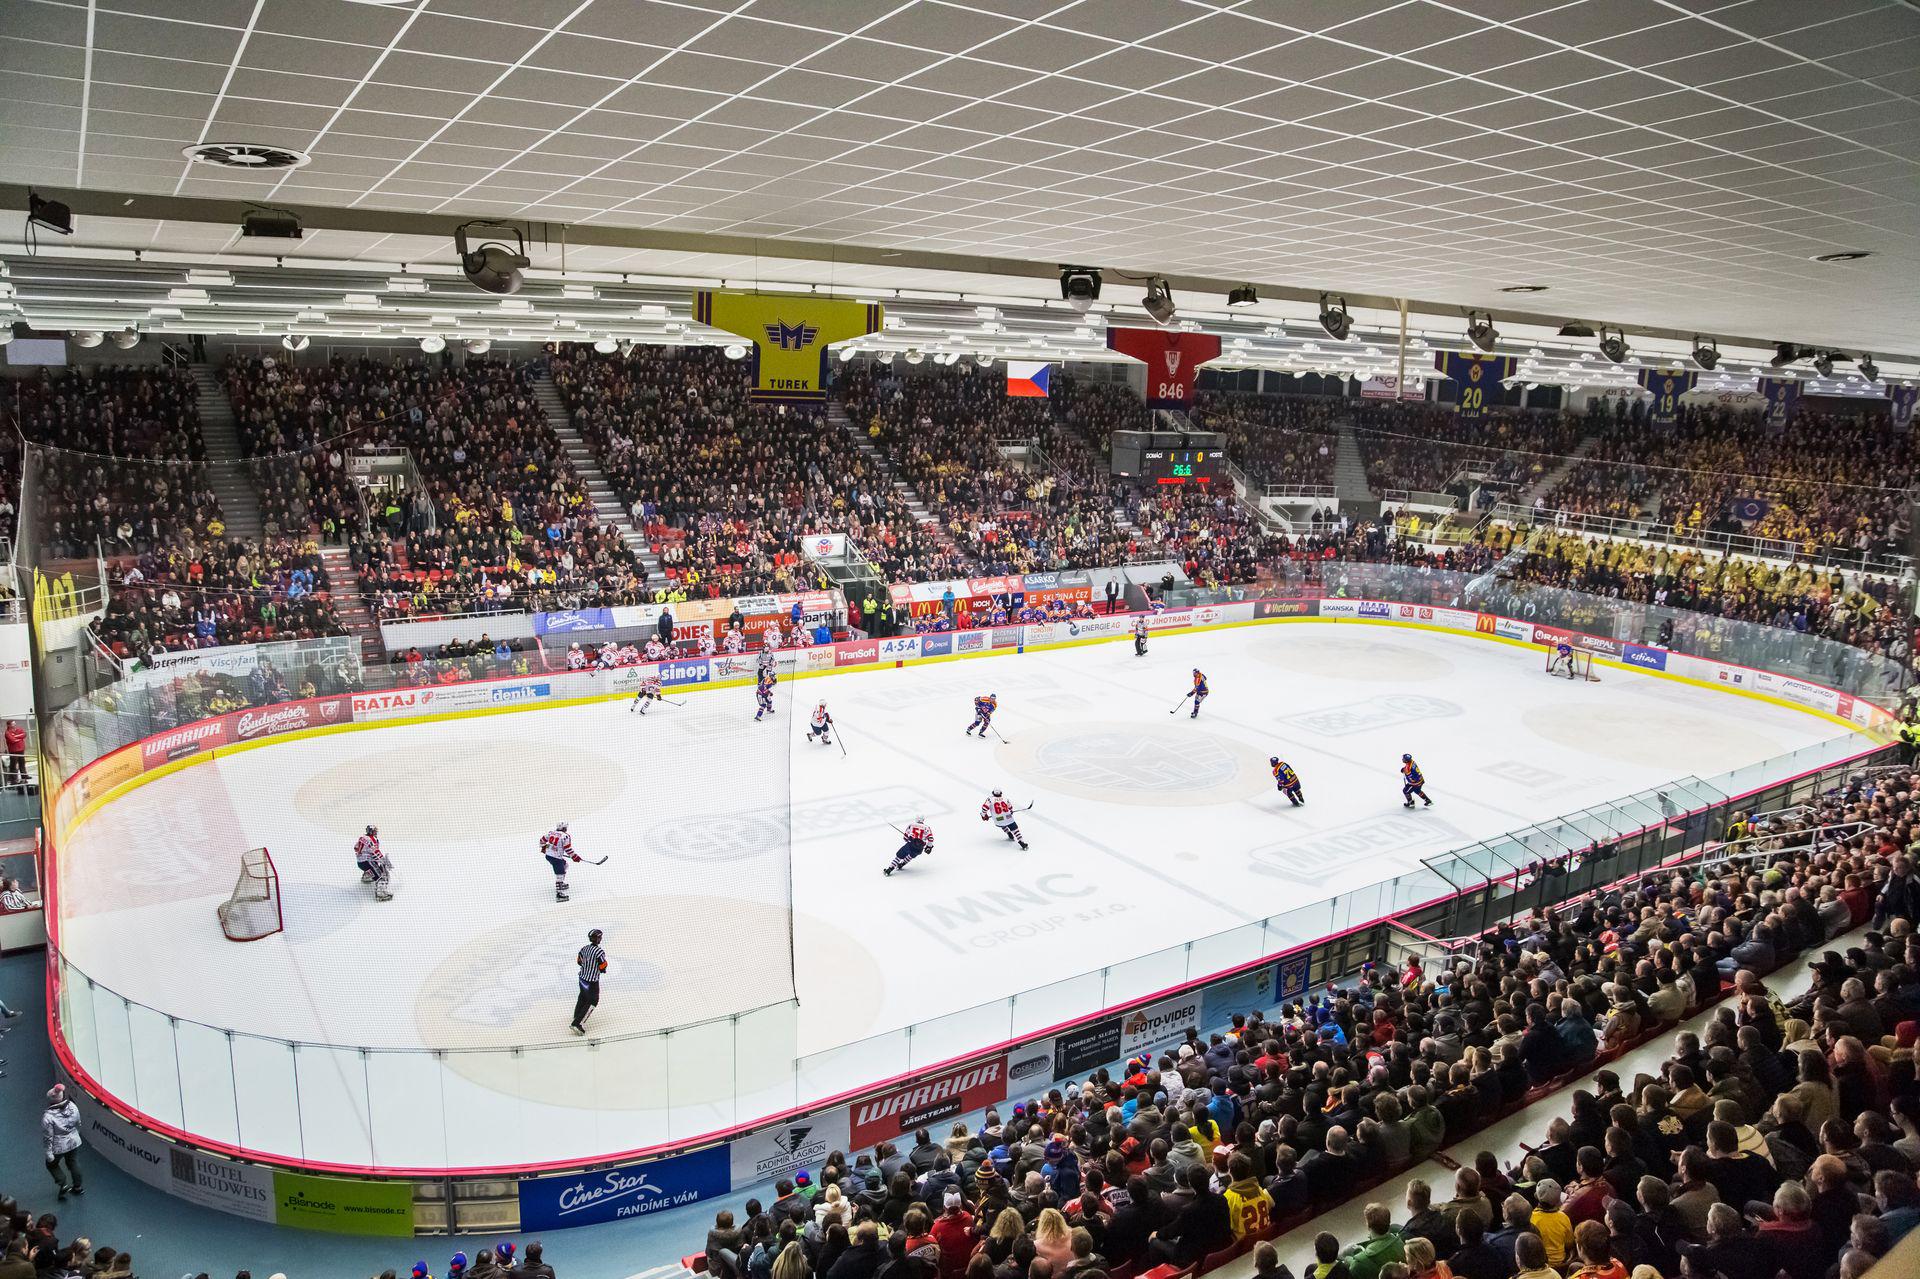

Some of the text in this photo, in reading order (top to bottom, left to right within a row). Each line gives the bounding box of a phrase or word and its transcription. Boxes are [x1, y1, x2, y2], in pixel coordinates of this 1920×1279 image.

[770, 378, 808, 390] TUREK
[1158, 382, 1184, 399] 846
[1462, 387, 1482, 409] 20
[1660, 394, 1674, 413] 19
[1773, 401, 1786, 417] 22
[1197, 451, 1204, 462] 0
[1024, 575, 1056, 584] ASARKO
[1042, 590, 1089, 602] SKUINA ČEZ
[1081, 621, 1121, 633] ENERGIE AG
[1151, 614, 1191, 624] JIHOTRANS
[1582, 636, 1616, 650] DERPAL
[807, 651, 833, 661] Teplo
[838, 648, 876, 660] TranSoft
[661, 664, 707, 681] sinop
[353, 694, 416, 711] RATAJ
[237, 706, 309, 737] Budweiser
[146, 722, 222, 756] WARRIOR
[994, 801, 1009, 814] 69
[911, 827, 925, 841] 51
[969, 902, 1137, 949] GROUP s.r.o.
[1134, 1004, 1196, 1035] FOTO-VIDEO
[856, 1063, 1001, 1127] WARRIOR
[92, 1119, 161, 1165] MOTOR JIKOV
[756, 1143, 827, 1173] RADIMÍR LAGRON
[197, 1159, 248, 1184] HOTEL
[198, 1173, 267, 1202] BUDWEIS
[558, 1171, 649, 1211] CineStar
[288, 1195, 336, 1211] Bisnode
[343, 1204, 406, 1215] www.bisnode.cz
[616, 1189, 698, 1217] FANDÍME VÁM
